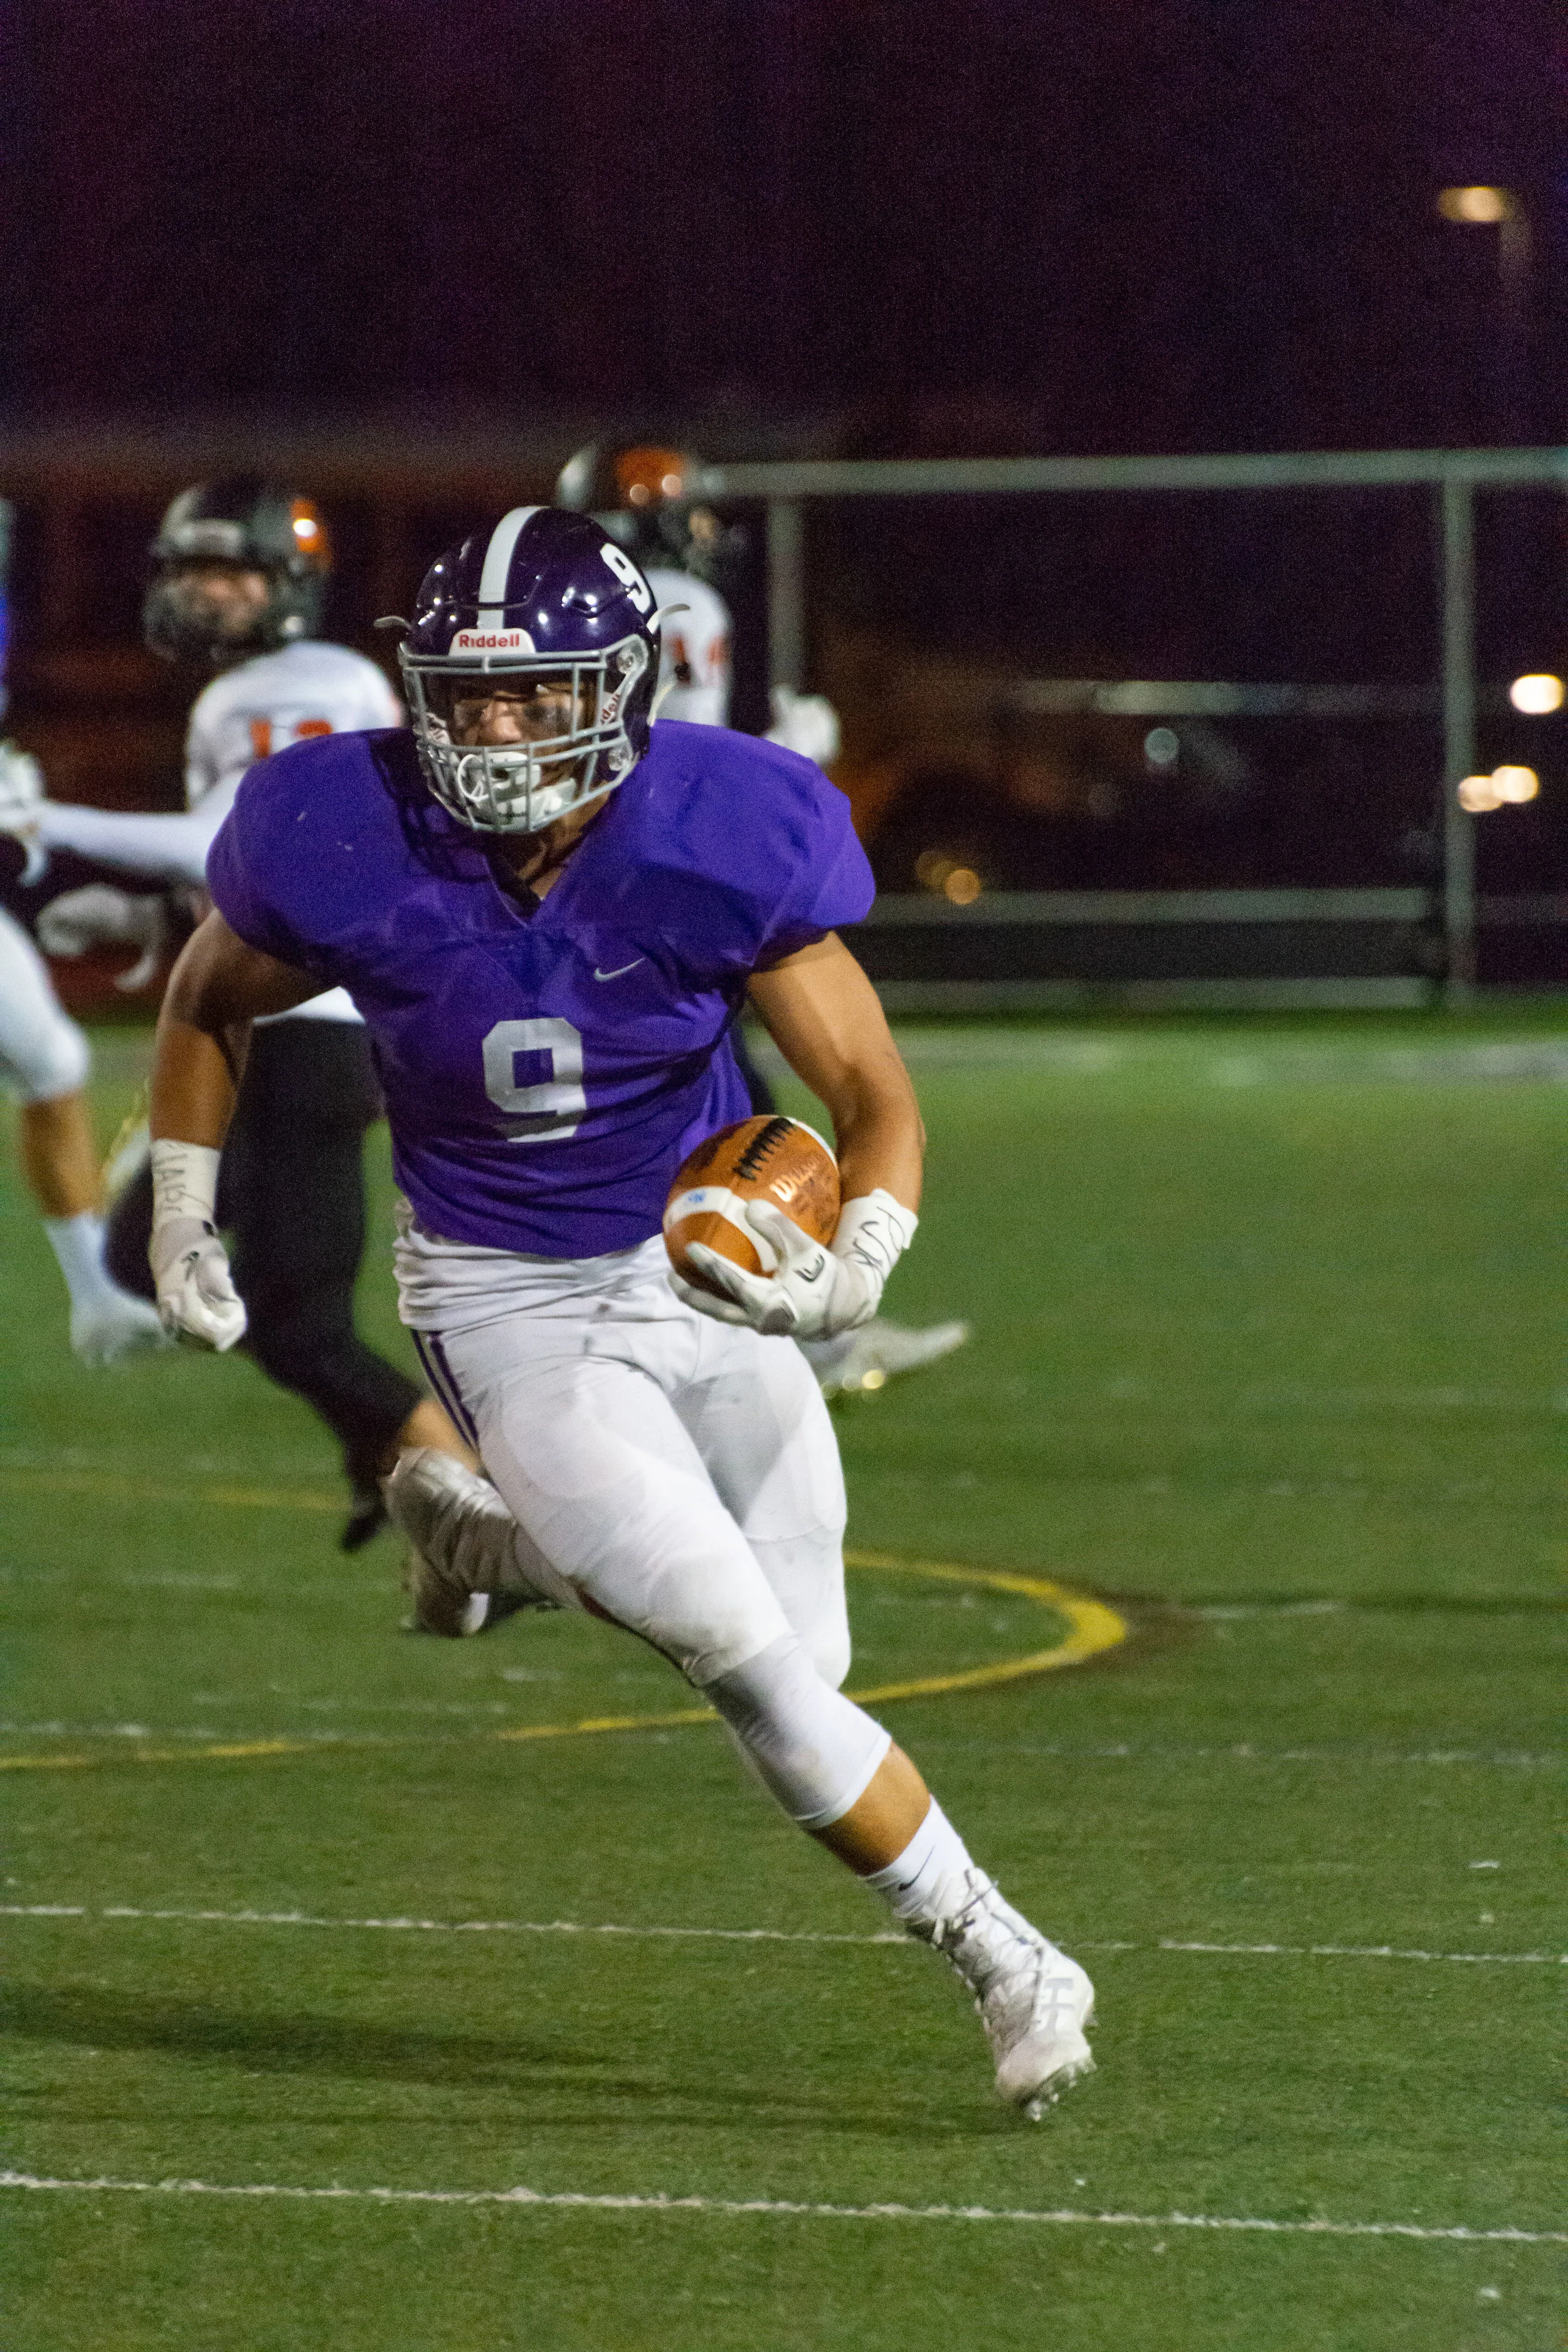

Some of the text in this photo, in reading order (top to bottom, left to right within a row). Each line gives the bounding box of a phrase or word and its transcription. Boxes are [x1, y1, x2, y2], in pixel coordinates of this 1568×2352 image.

[600, 543, 653, 615] 9
[458, 633, 520, 648] Riddell
[481, 1017, 587, 1143] 9
